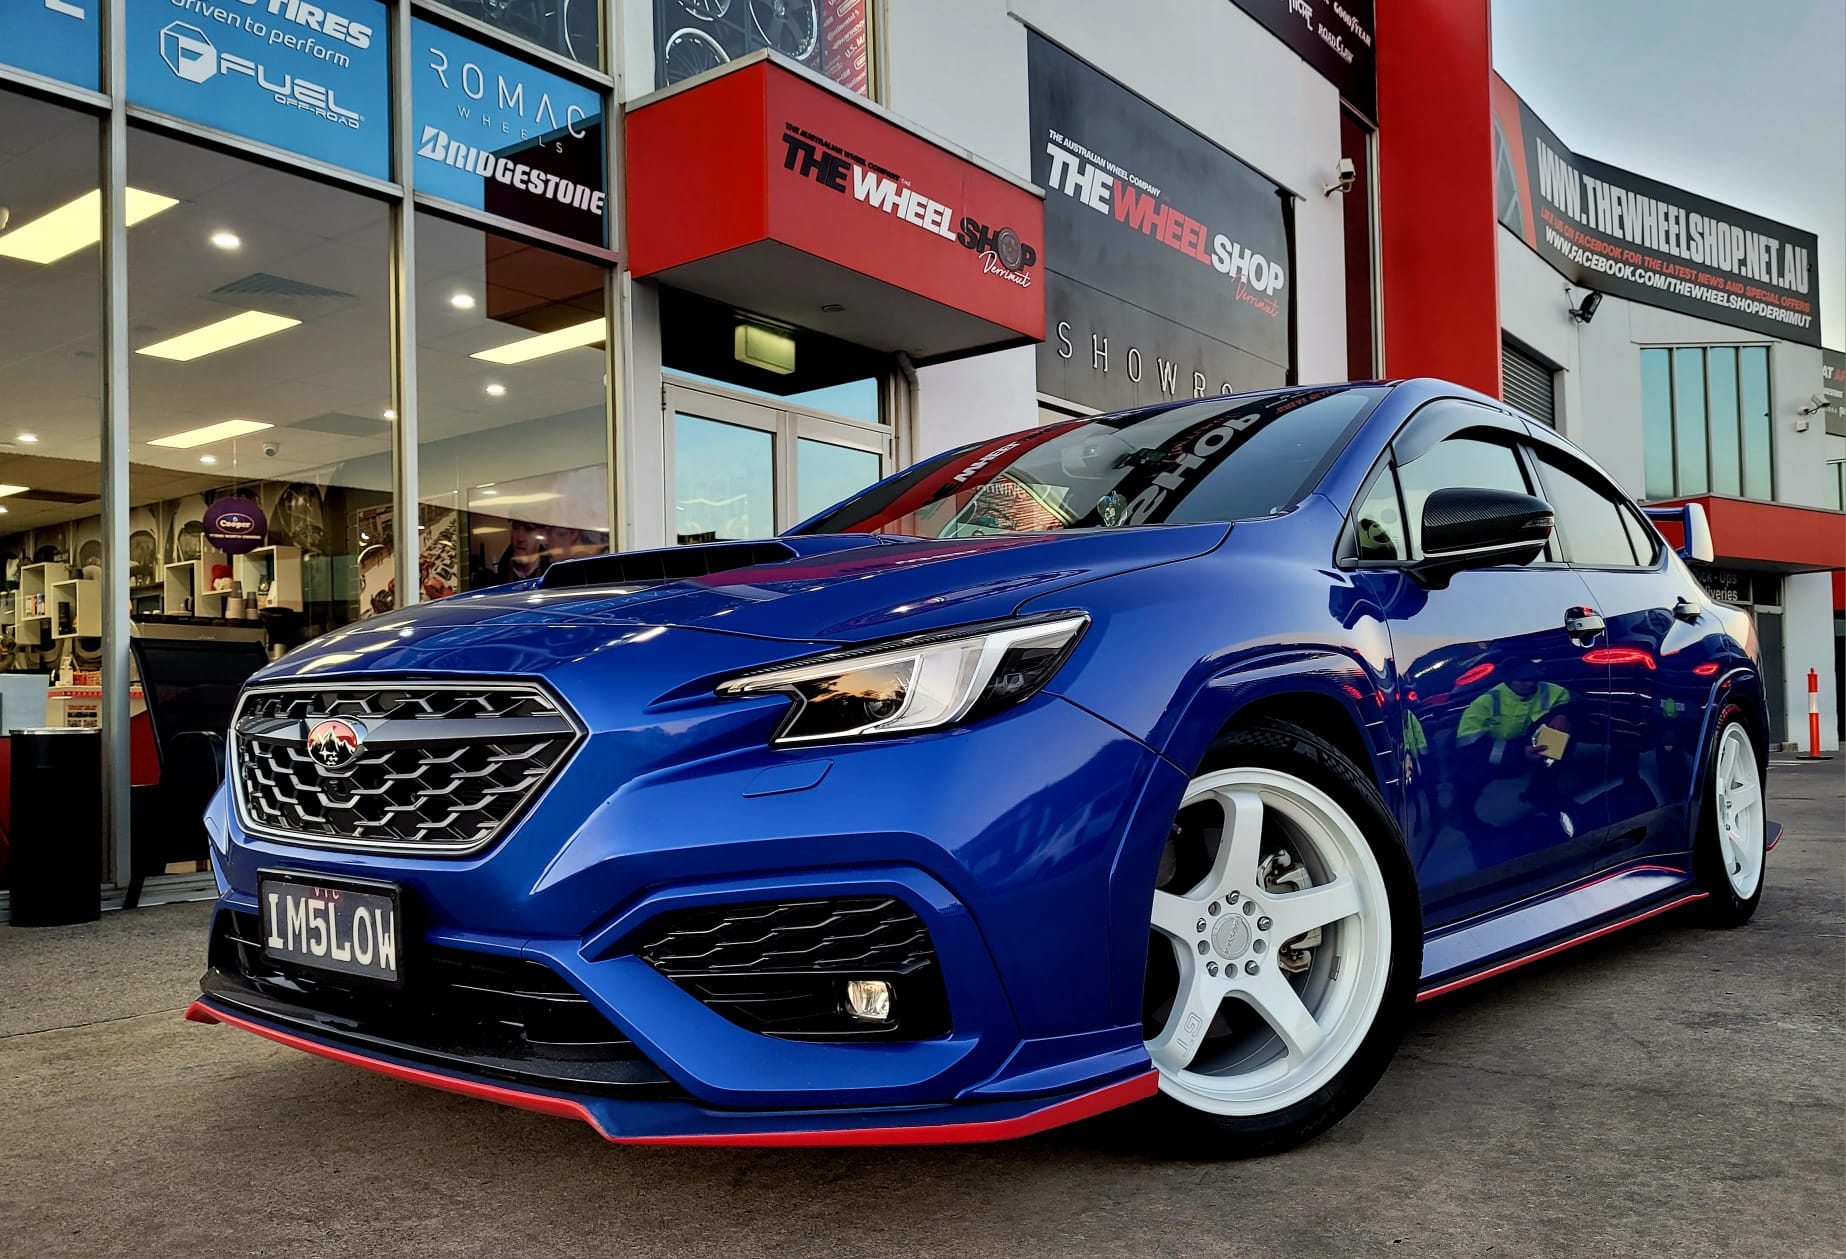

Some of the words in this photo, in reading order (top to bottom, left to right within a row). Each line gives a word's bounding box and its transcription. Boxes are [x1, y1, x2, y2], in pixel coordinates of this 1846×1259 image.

[244, 16, 267, 37] to
[269, 29, 350, 68] perform
[267, 0, 373, 49] TIRES
[220, 52, 361, 121] FUEL
[274, 92, 360, 129] OFF-ROAD
[429, 47, 586, 139] ROMAC
[457, 104, 563, 154] WHEELS
[785, 121, 800, 134] THE
[800, 129, 844, 155] AUSTRALIAN
[844, 149, 867, 167] WHEEL
[868, 161, 901, 181] COMPANY
[1048, 128, 1064, 145] THE
[1063, 137, 1107, 169] AUSTRALIAN
[1106, 159, 1129, 181] WHEEL
[1129, 173, 1161, 197] COMPANY
[416, 124, 606, 215] BRIDGESTONE
[782, 132, 852, 194] THE
[852, 164, 957, 241] WHEEL
[1536, 136, 1809, 294] WWW.THEWHEELSHOP.NET.AU
[1540, 205, 1554, 225] LIKE
[1554, 216, 1564, 232] US
[1563, 222, 1574, 240] ON
[1574, 228, 1622, 259] FACEBOOK
[1623, 249, 1642, 265] FOR
[1644, 254, 1662, 270] THE
[1663, 261, 1697, 281] LATEST
[1697, 271, 1725, 289] NEWS
[1725, 279, 1744, 295] AND
[1745, 284, 1779, 304] SPECIAL
[1780, 294, 1810, 313] OFFERS
[1545, 225, 1812, 328] WWW.FACEBOOK.COM/THEWHEELSHOPDERRIMUT
[219, 519, 251, 529] Cooper
[1719, 570, 1737, 587] Ups
[268, 893, 396, 971] IM5LOW
